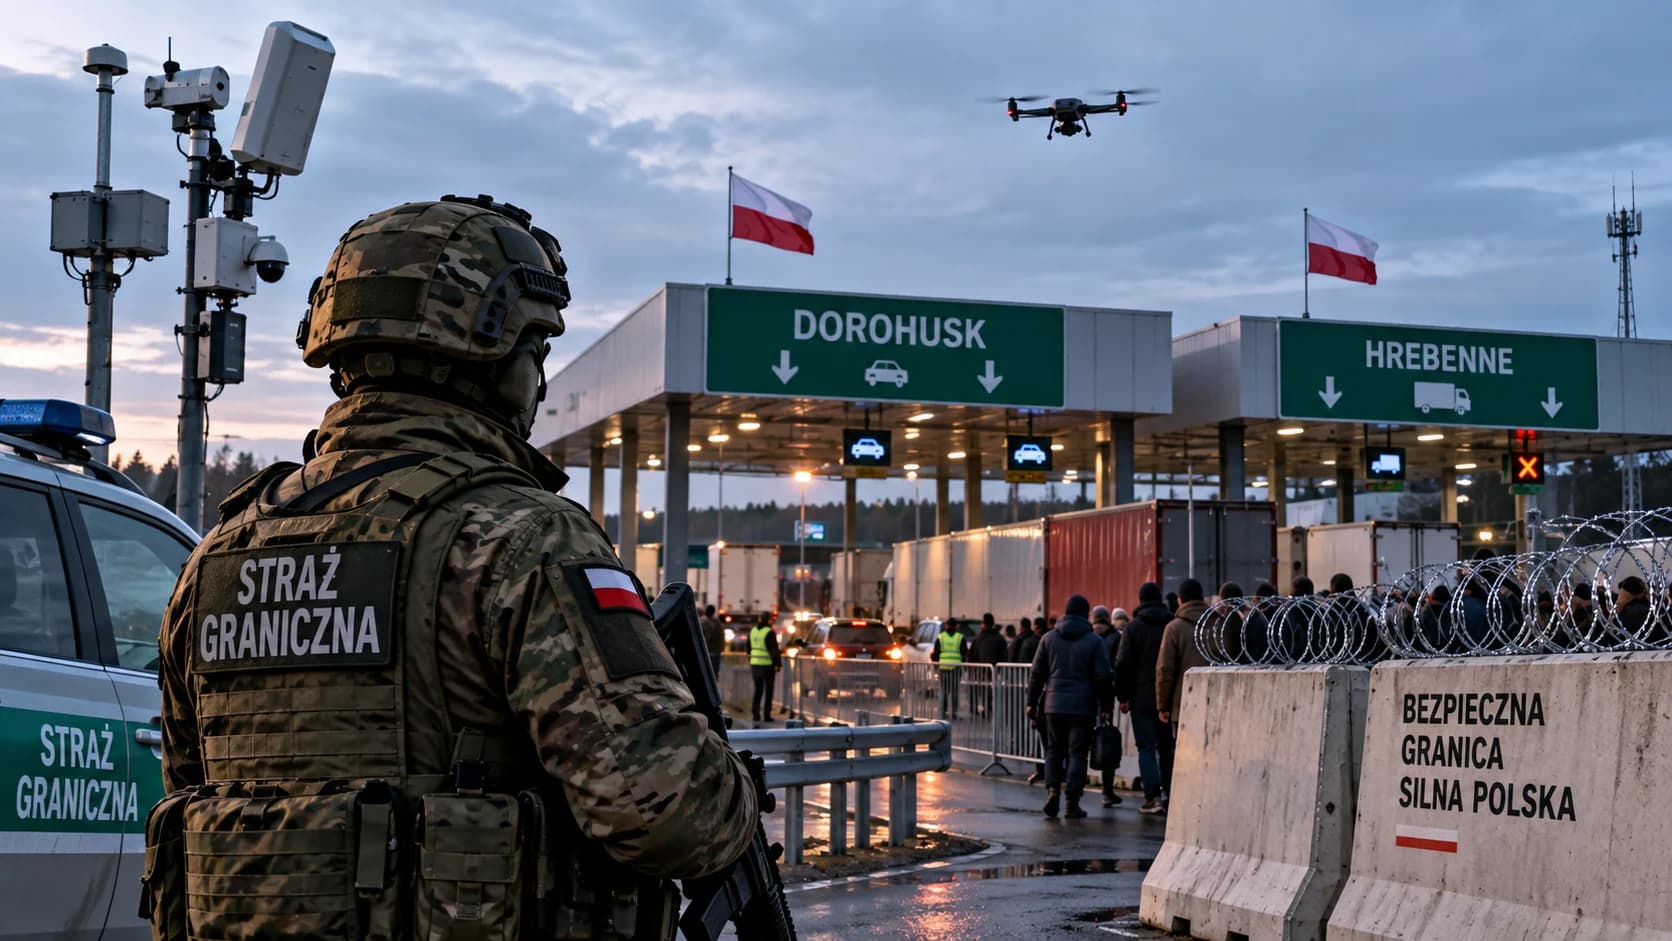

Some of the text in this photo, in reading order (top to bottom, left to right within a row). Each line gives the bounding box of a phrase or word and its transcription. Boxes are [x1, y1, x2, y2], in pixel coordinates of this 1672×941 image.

[794, 309, 987, 349] DOROHUSK
[1365, 340, 1514, 376] HREBENNE
[237, 545, 342, 605] STRAŻ
[200, 606, 380, 661] GRANICZNA
[1402, 692, 1546, 727] BEZPIECZNA
[40, 723, 114, 770] STRAŻ
[1401, 734, 1504, 770] GRANICA
[16, 775, 138, 822] GRANICZNA
[1399, 776, 1577, 822] SILNA POLSKA
